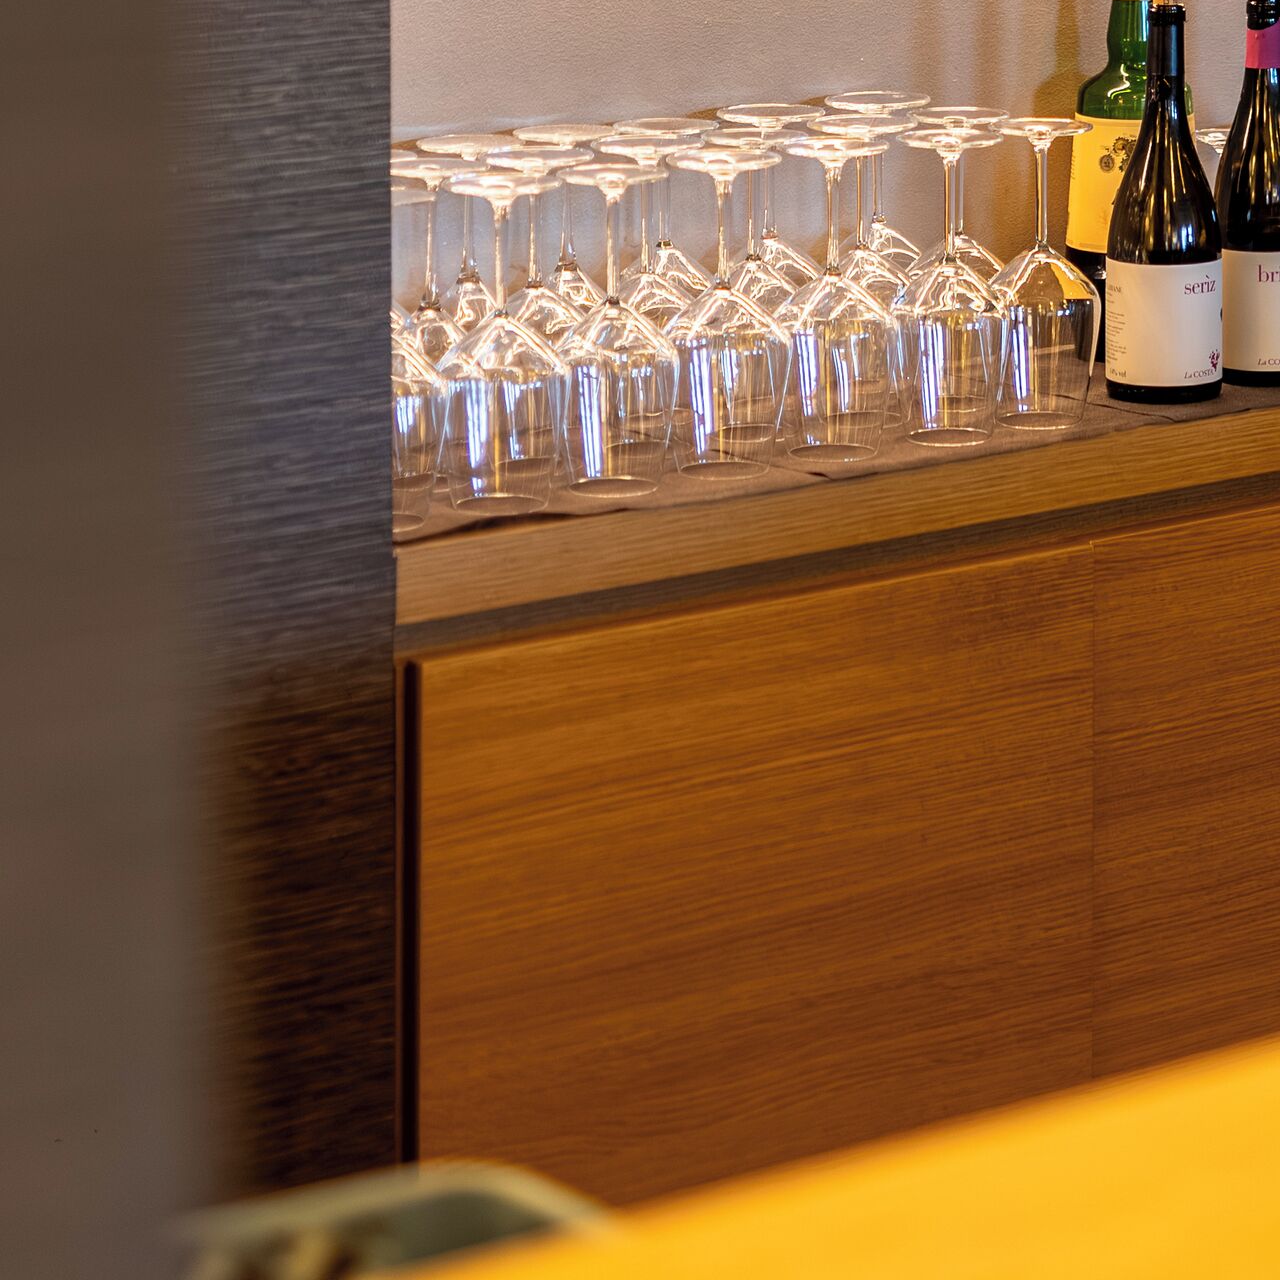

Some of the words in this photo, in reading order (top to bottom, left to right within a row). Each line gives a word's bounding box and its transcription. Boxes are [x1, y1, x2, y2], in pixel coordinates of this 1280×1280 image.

[1183, 274, 1216, 295] serìz
[1257, 358, 1267, 366] La
[1184, 371, 1192, 379] La
[1193, 369, 1216, 378] COSTA
